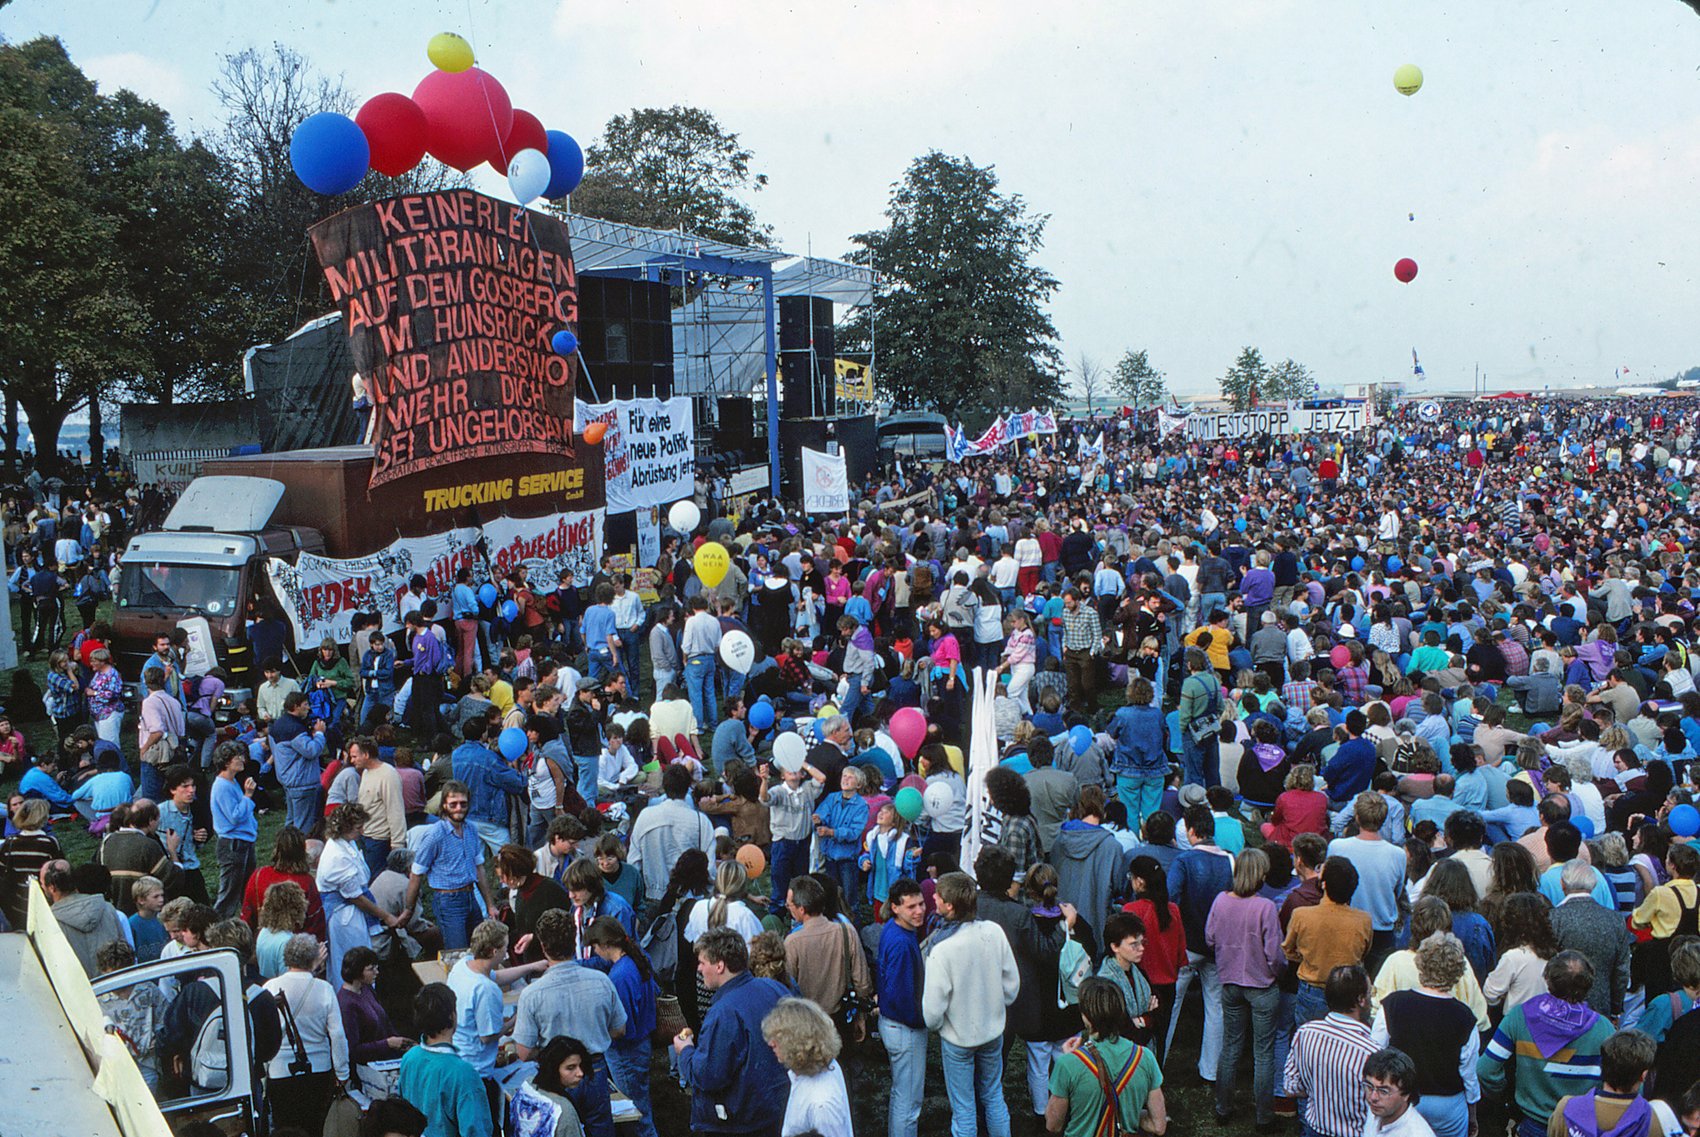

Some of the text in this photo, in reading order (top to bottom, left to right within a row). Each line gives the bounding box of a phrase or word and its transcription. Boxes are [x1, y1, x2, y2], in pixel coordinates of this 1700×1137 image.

[375, 191, 530, 244] KEINERLEI
[323, 229, 576, 302] MILITÄRANLAGEN
[349, 267, 578, 337] AUF DEM GOSBERG
[377, 303, 555, 358] IM HUNSRÜCK
[373, 337, 569, 404] UND ANDERSWO
[386, 374, 547, 432] WEHR DICH
[628, 407, 672, 434] Für eine
[1187, 409, 1361, 442] ATOMTESTSTOPP JETZT
[376, 429, 415, 472] SEI
[428, 409, 574, 454] UNGEHORSAM
[629, 441, 657, 461] neue
[424, 468, 585, 512] TRUCKING SERVICE
[630, 462, 678, 489] Abrüstung
[702, 552, 724, 561] WAA
[702, 560, 724, 568] NEIN
